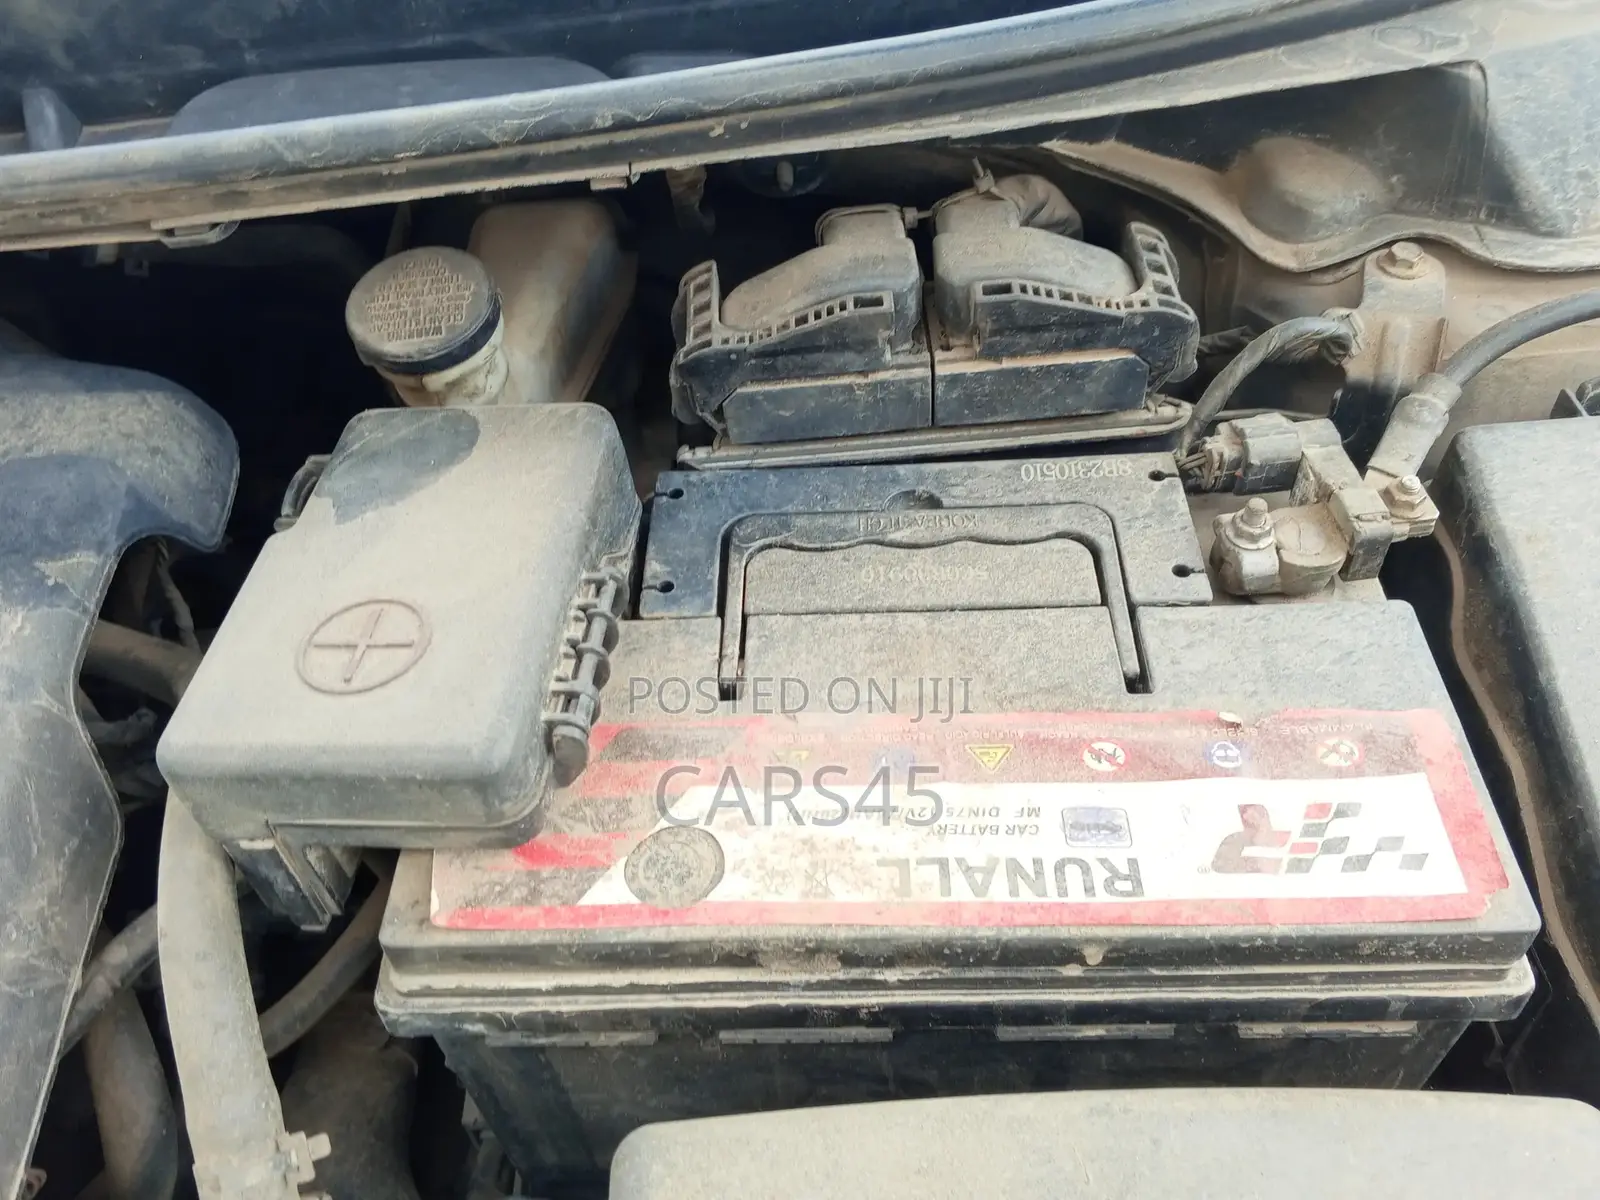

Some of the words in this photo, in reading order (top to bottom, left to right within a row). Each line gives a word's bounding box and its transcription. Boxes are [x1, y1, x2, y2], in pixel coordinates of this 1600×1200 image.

[387, 326, 443, 342] WARNING
[1013, 806, 1042, 819] MF
[925, 823, 1000, 837] BATTERY
[1004, 823, 1041, 837] CAR
[877, 857, 1146, 899] RUNALL
